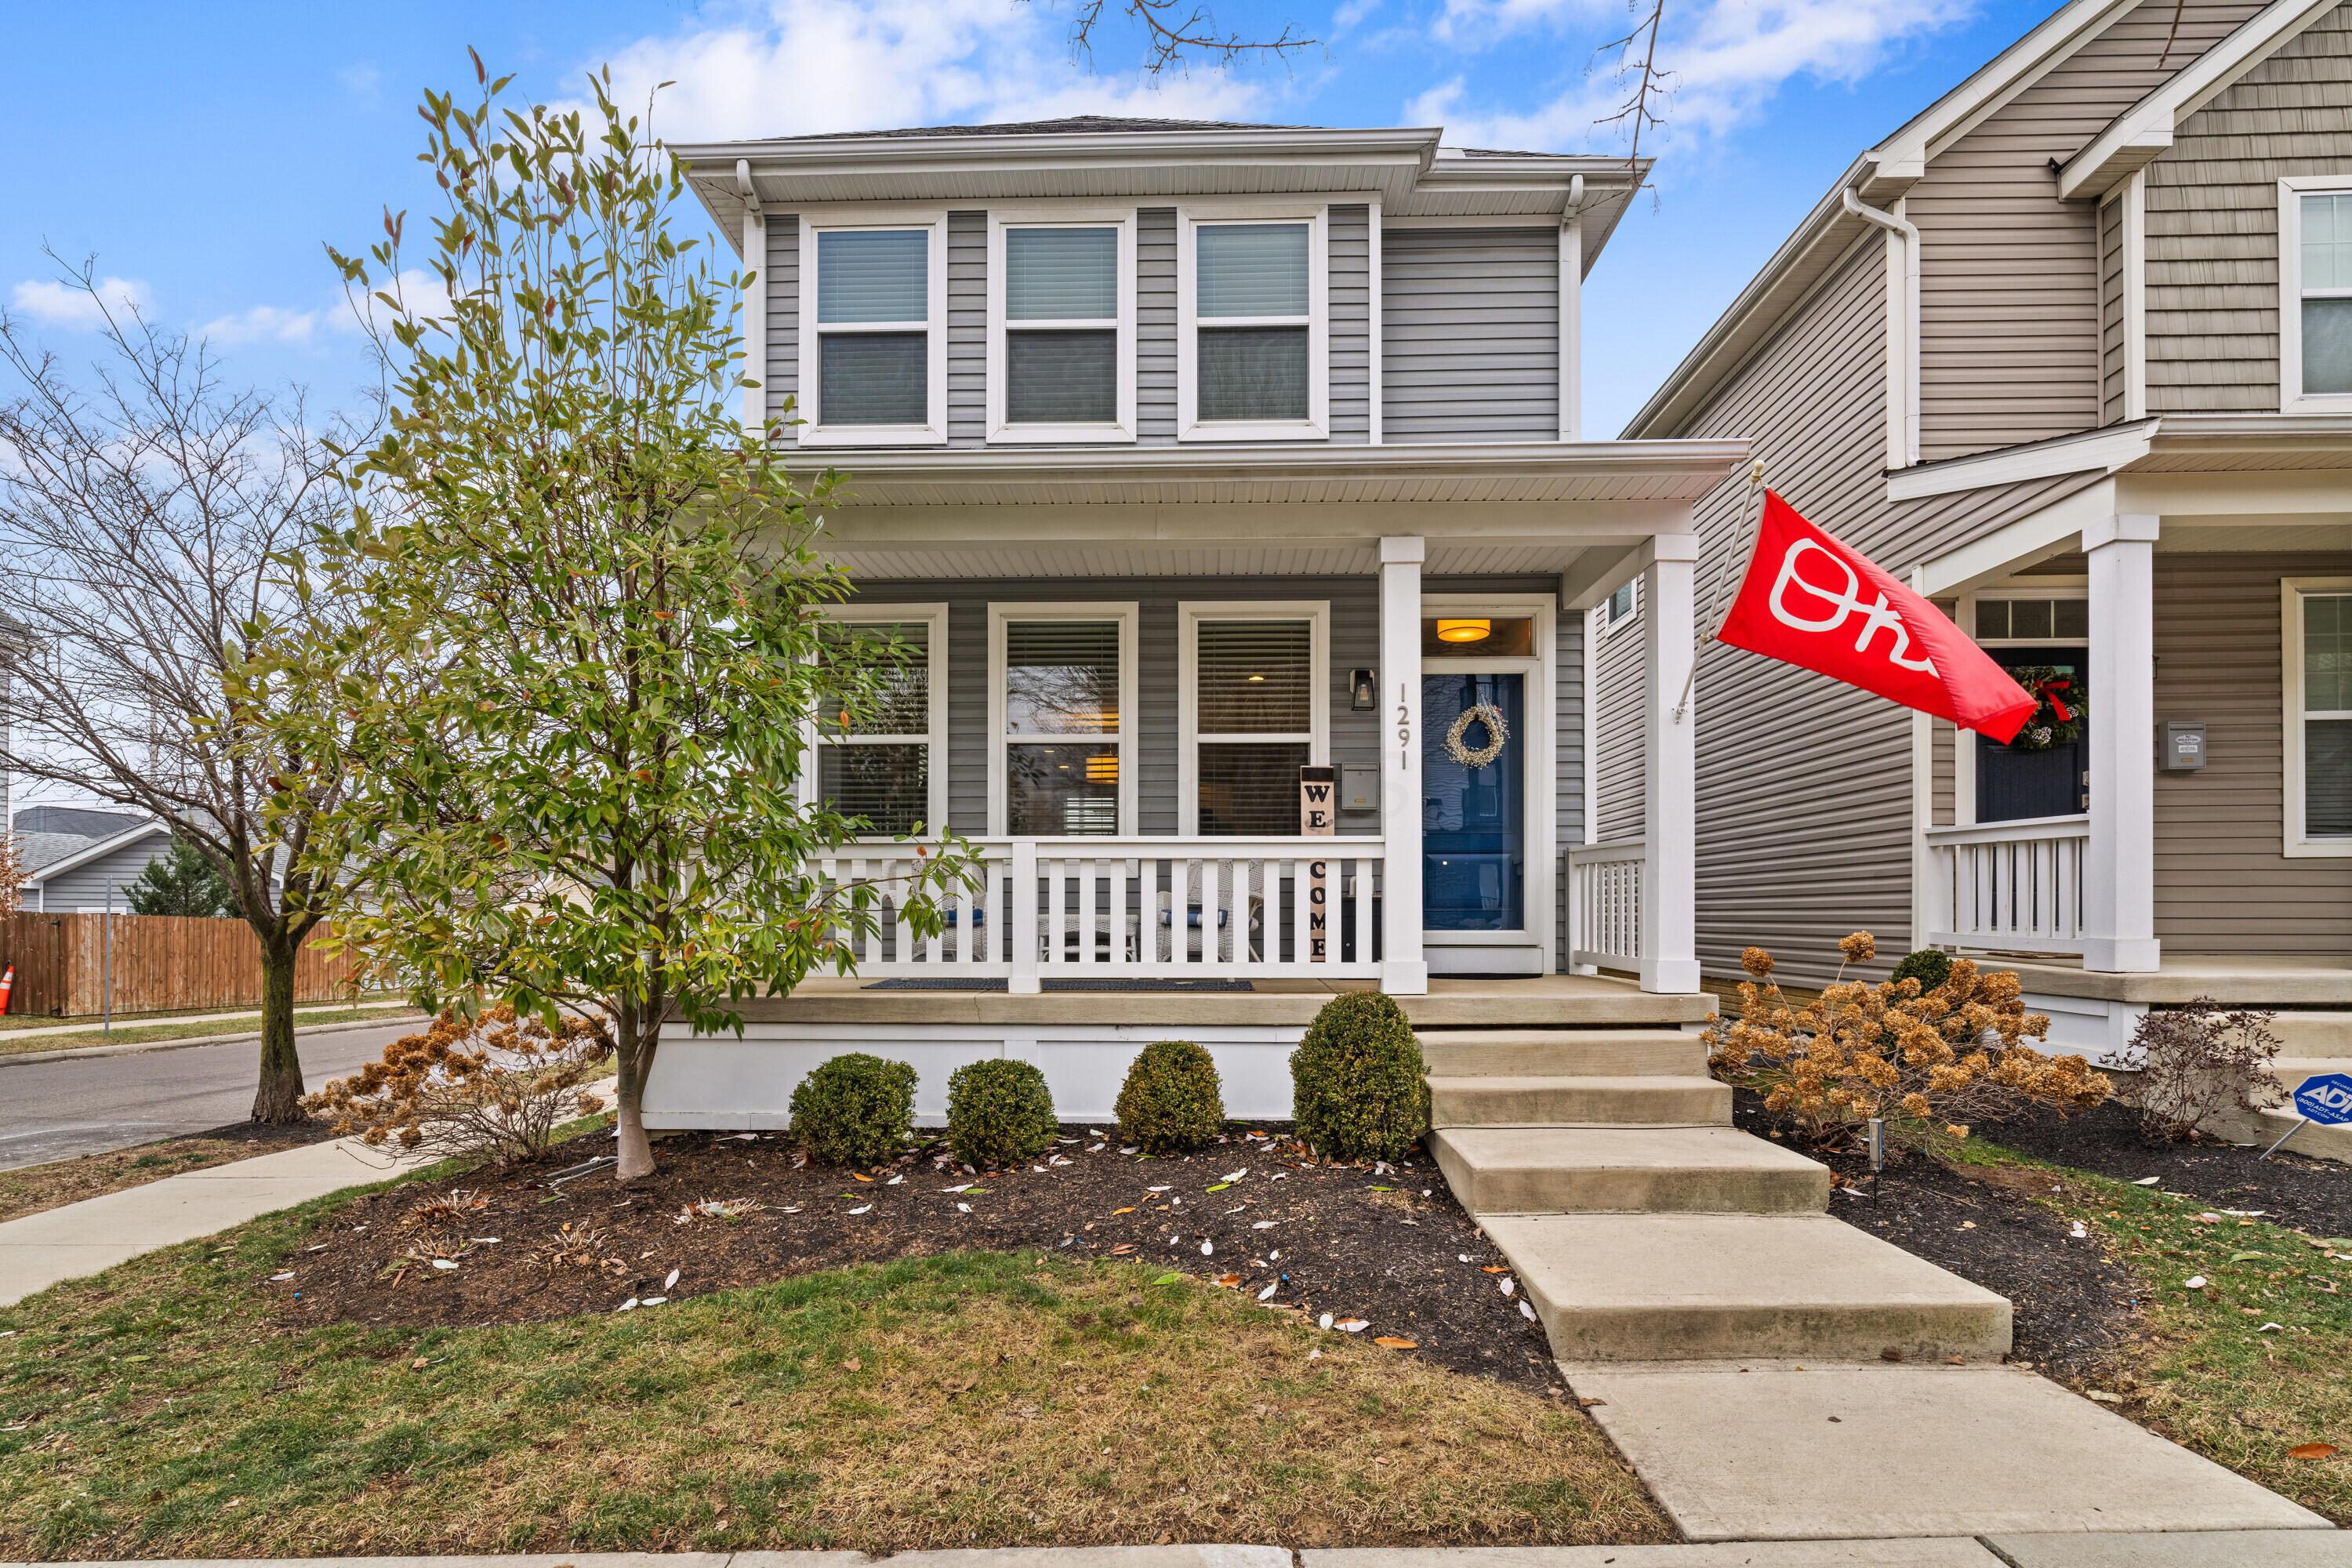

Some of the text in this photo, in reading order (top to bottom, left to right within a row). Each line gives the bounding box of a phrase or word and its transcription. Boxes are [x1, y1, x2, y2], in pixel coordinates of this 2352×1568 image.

[1397, 683, 1410, 770] 1291
[1305, 785, 1330, 956] WECOME
[2301, 1084, 2352, 1114] ADT
